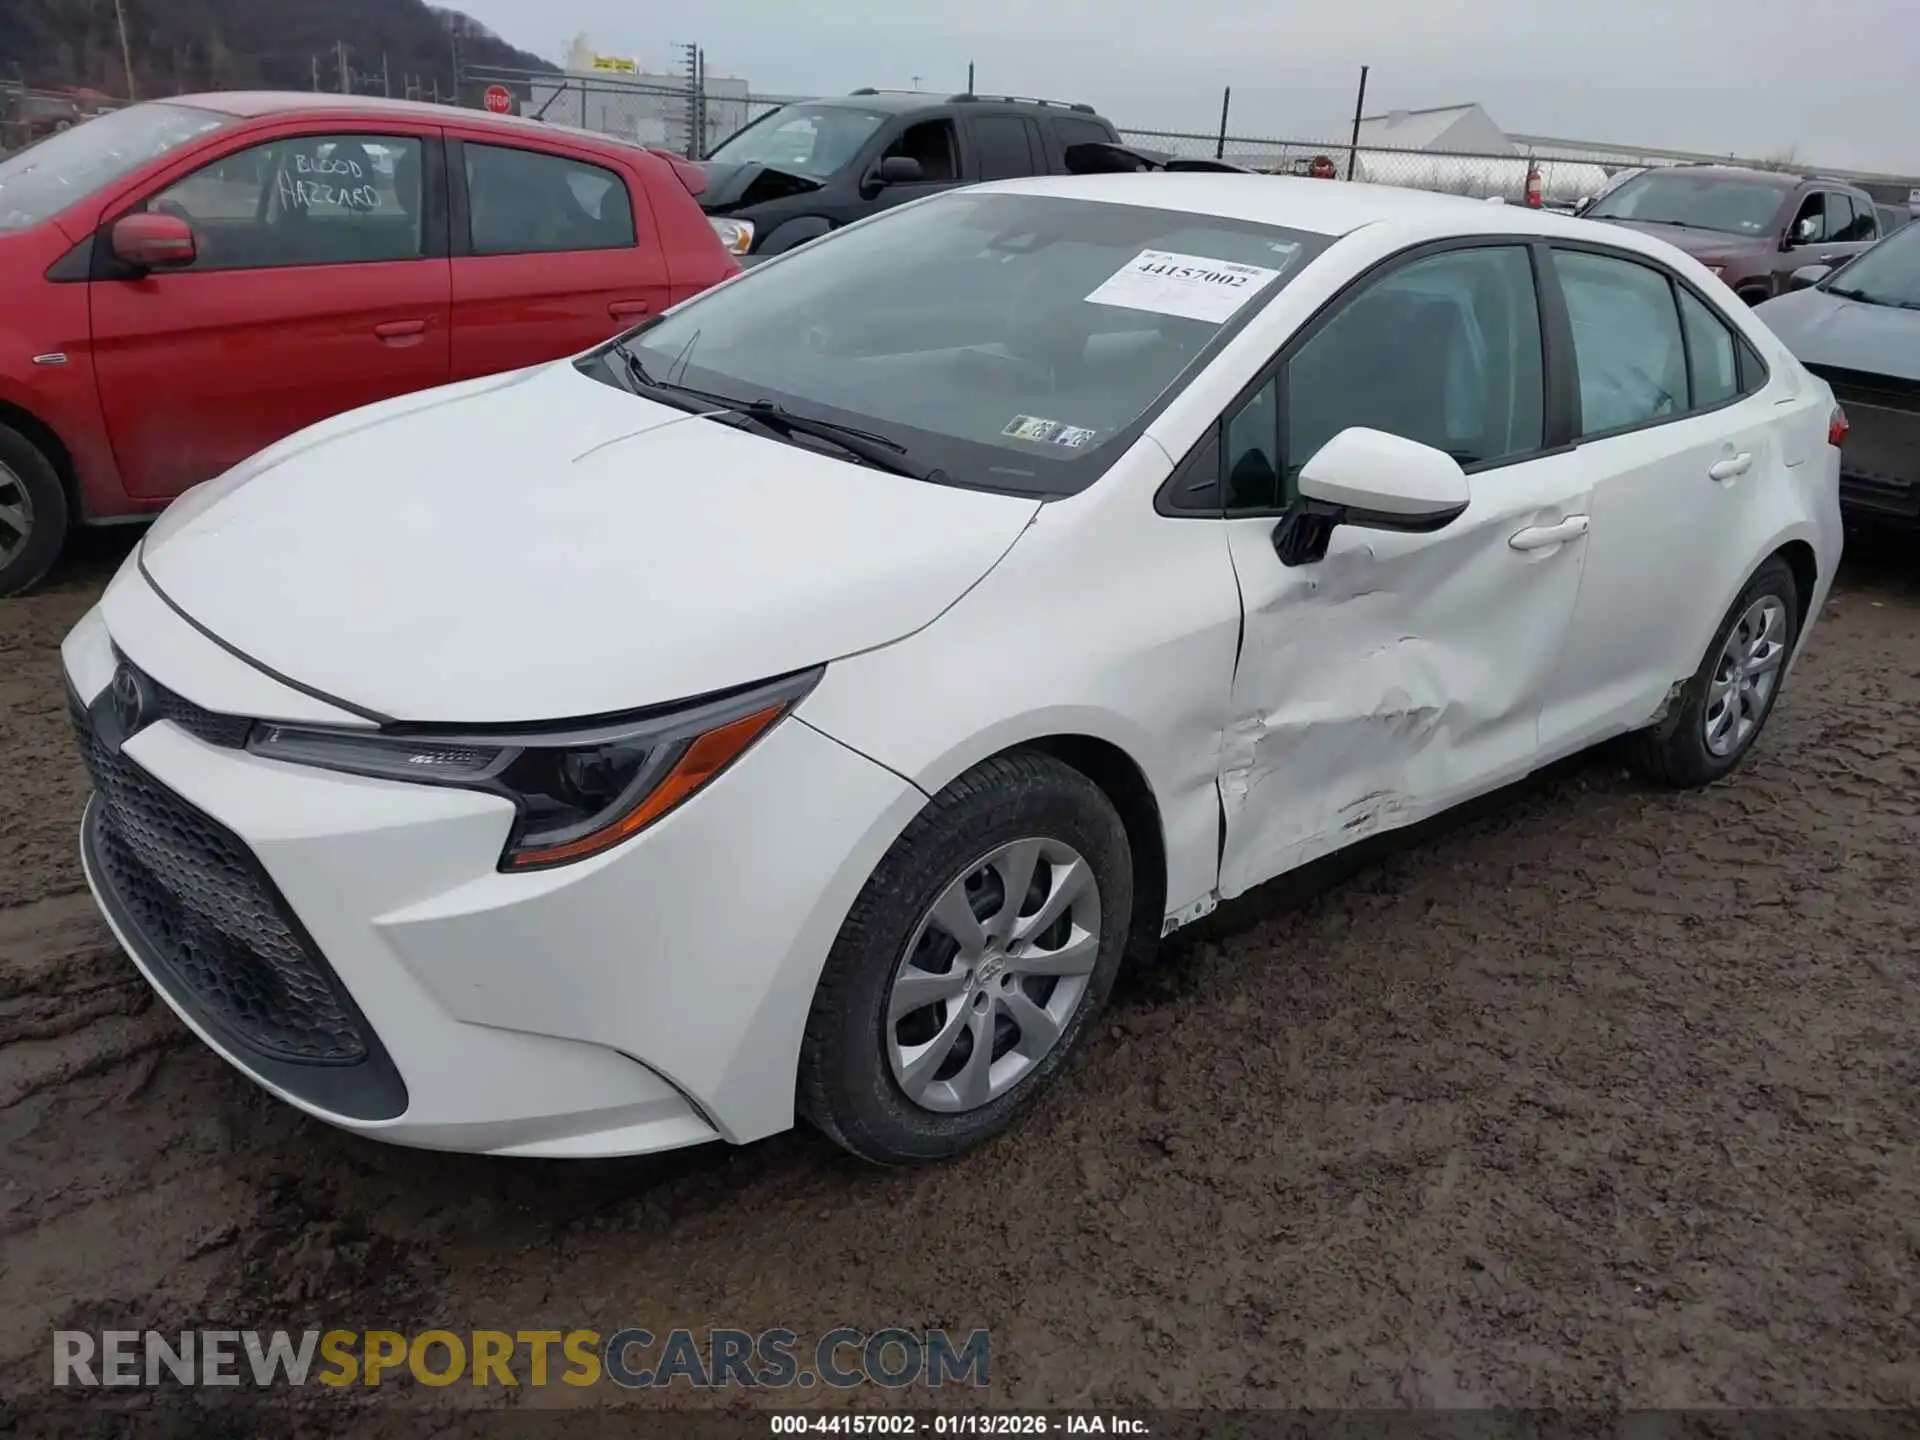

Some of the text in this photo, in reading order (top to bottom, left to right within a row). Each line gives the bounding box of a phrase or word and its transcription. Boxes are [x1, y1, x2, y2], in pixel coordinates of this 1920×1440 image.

[486, 94, 510, 108] STOP
[295, 154, 363, 178] BLOOD
[1138, 262, 1248, 288] 44157002
